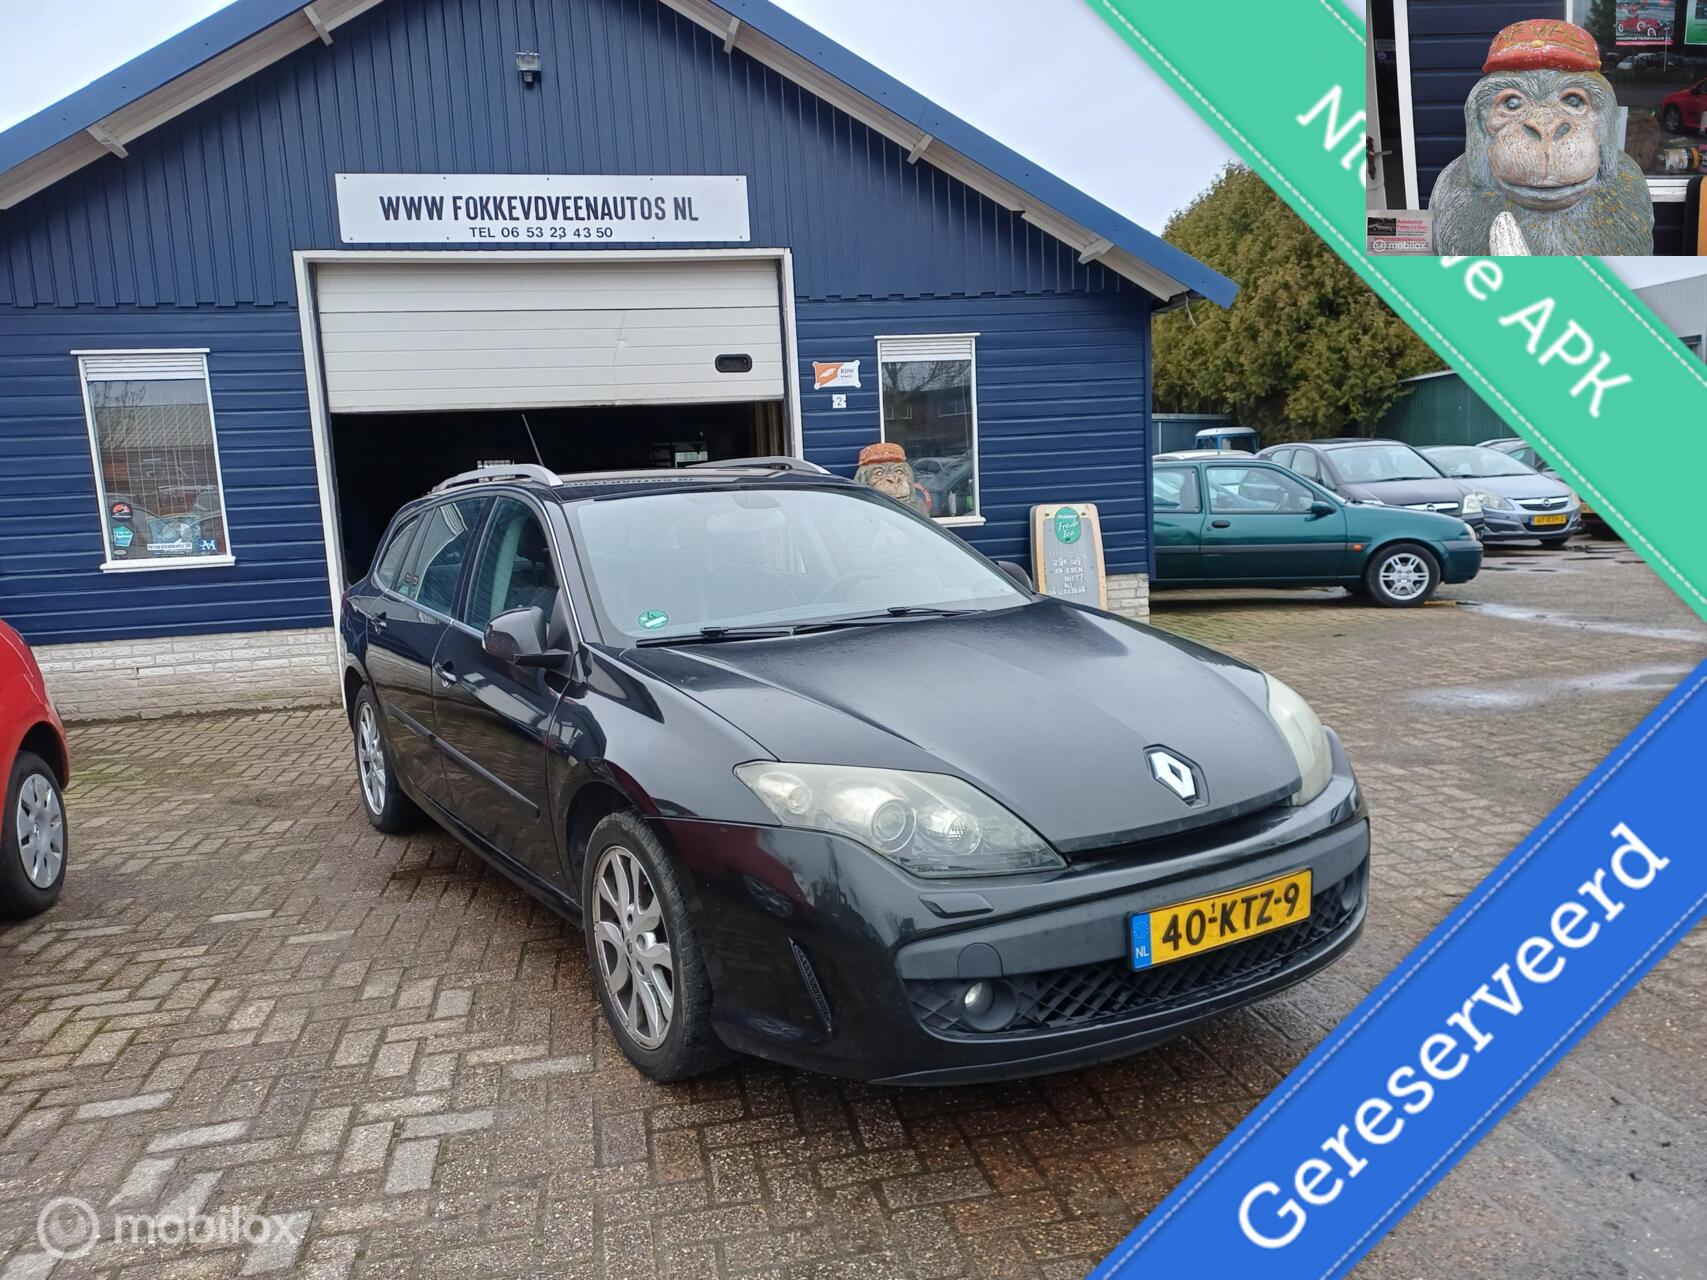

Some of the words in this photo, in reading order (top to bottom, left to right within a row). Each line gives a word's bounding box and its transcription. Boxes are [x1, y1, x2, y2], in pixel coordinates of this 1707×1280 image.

[379, 195, 445, 221] WWW
[452, 195, 667, 221] FOKKEVDVEENAUTOS
[673, 196, 699, 221] NL
[469, 226, 496, 238] TEL
[501, 226, 520, 238] 06
[526, 226, 544, 238] 53
[550, 226, 567, 239] 23
[573, 227, 592, 238] 43
[596, 226, 613, 238] 50
[836, 396, 843, 407] 2
[1135, 945, 1150, 959] NL
